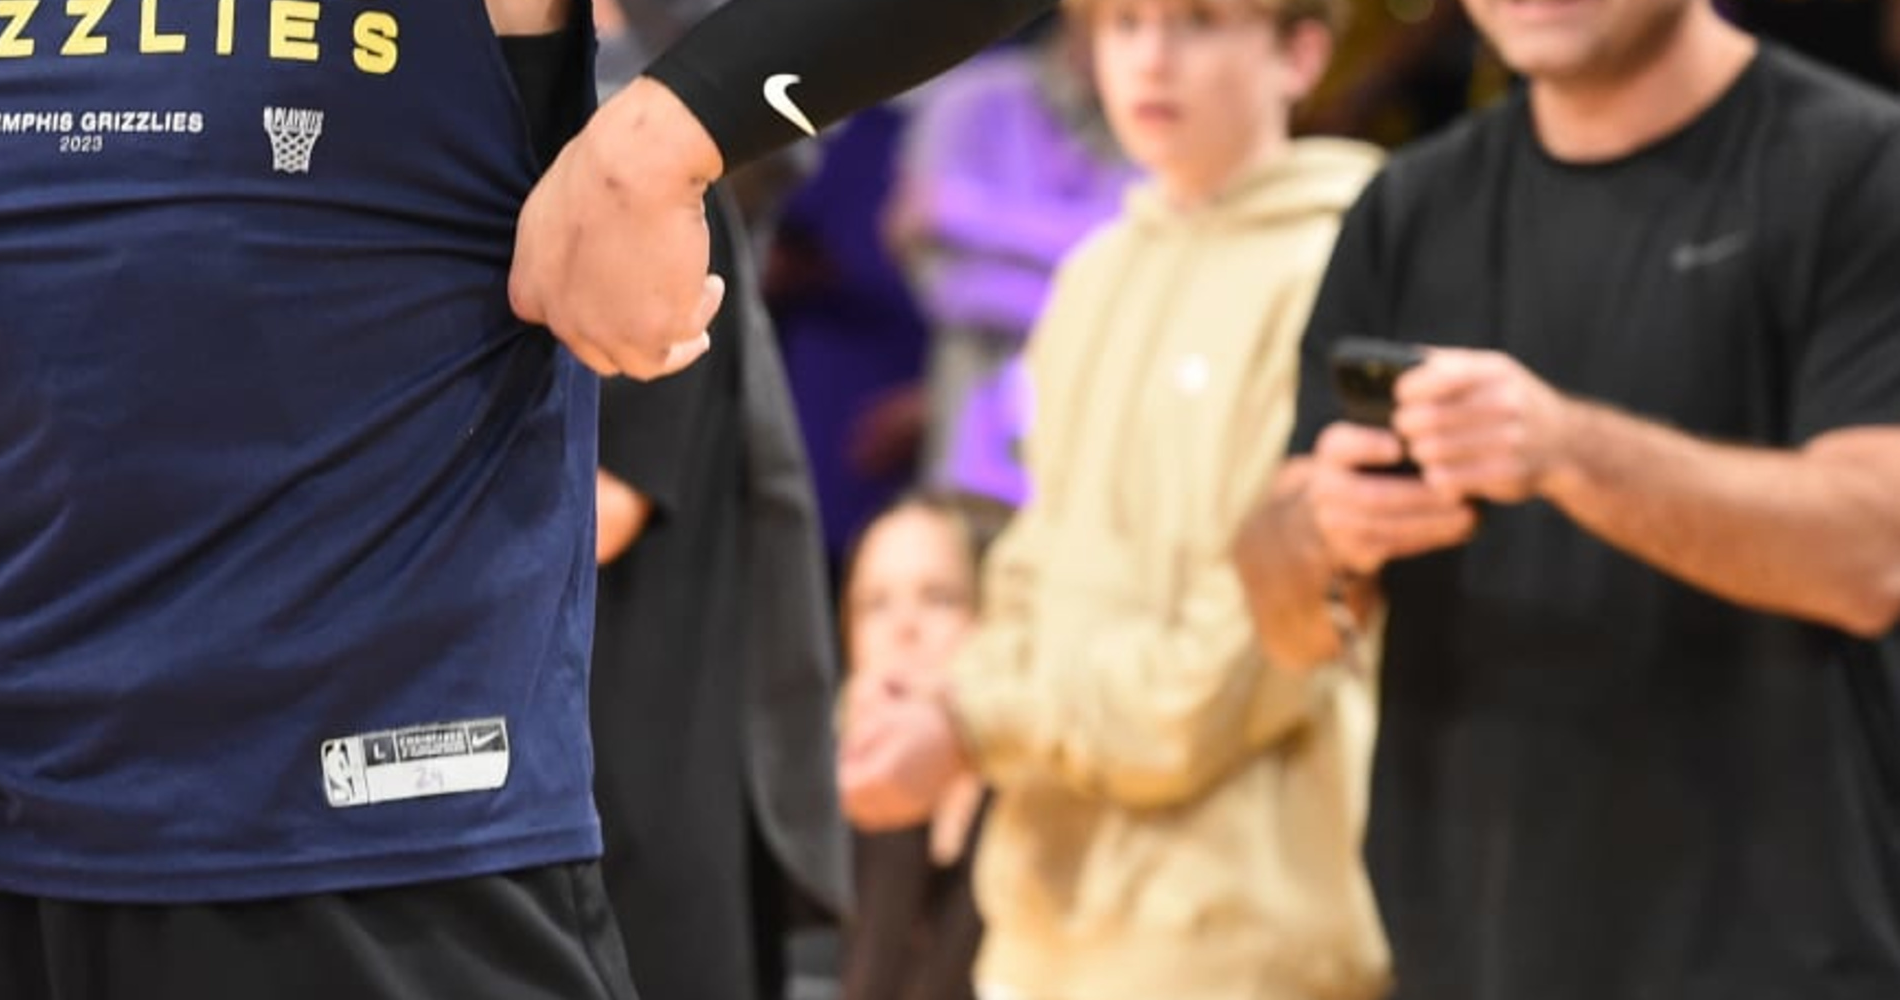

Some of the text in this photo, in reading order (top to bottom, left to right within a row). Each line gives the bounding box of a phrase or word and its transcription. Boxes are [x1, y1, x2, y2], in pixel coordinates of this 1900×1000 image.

[79, 110, 204, 133] GRIZZLIES
[58, 134, 104, 152] 2023
[373, 742, 387, 760] L
